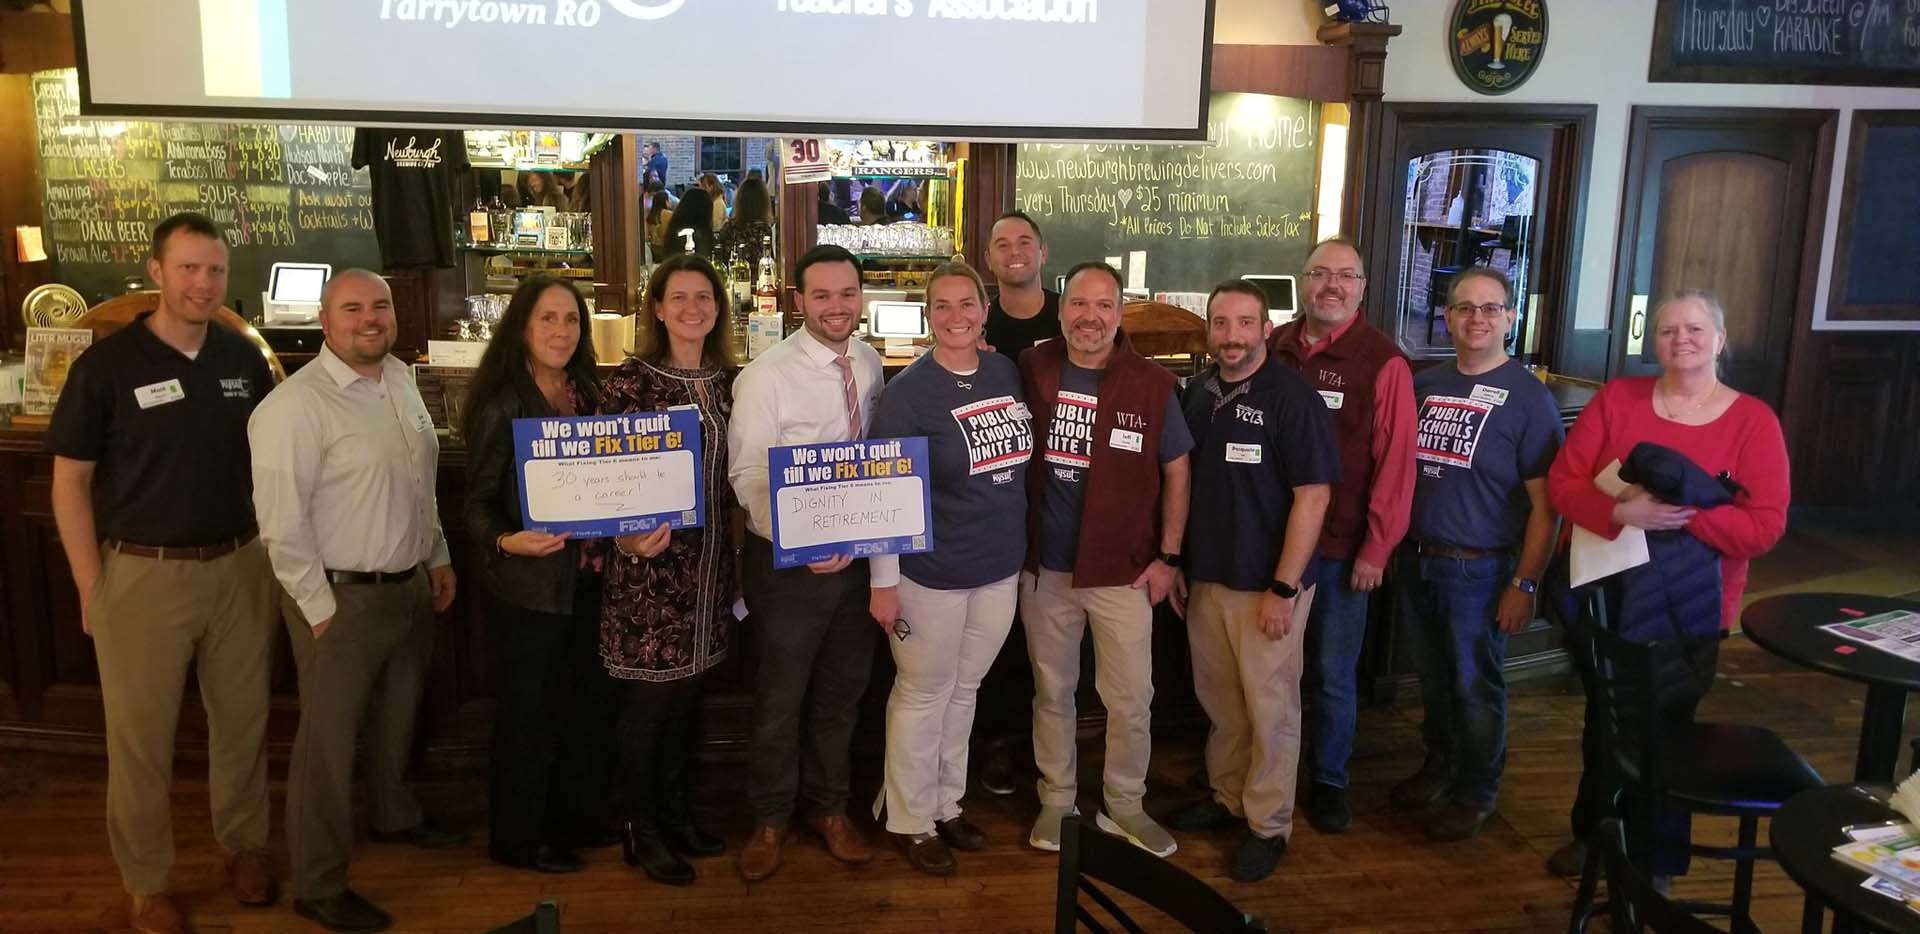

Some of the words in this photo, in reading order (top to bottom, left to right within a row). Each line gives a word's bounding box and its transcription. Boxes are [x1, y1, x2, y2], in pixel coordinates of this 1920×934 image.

[554, 0, 600, 27] RO
[1680, 1, 1755, 53] Thursday
[1773, 16, 1841, 54] KARAOKE
[299, 126, 331, 145] HARD
[384, 136, 442, 168] Newburgh
[790, 139, 820, 164] 30
[74, 156, 126, 179] LAGERS
[857, 167, 934, 176] RANGERS
[299, 190, 321, 207] Ask
[1057, 185, 1118, 226] Thursday
[1136, 186, 1161, 213] $25
[1168, 187, 1230, 213] minimum
[81, 221, 116, 242] DARK
[117, 221, 149, 242] BEER
[299, 209, 348, 231] Cocktails
[1144, 216, 1173, 237] Prices
[1180, 216, 1193, 238] Do
[1196, 216, 1215, 238] Not
[1220, 214, 1253, 237] Include
[1256, 214, 1281, 238] Sales
[541, 420, 571, 439] We
[576, 416, 631, 438] won't
[634, 414, 671, 436] quit
[1426, 405, 1476, 424] PUBLIC
[971, 421, 1028, 447] SCHOOLS
[1417, 418, 1474, 440] SCHOOLS
[532, 440, 557, 458] till
[561, 439, 591, 457] we
[594, 436, 623, 455] Fix
[626, 434, 662, 452] Tier
[665, 431, 683, 449] 6!
[792, 448, 817, 466] We
[821, 443, 867, 463] won't
[869, 440, 903, 462] quit
[972, 438, 1013, 463] UNITE
[1018, 433, 1033, 452] US
[1453, 438, 1473, 456] US
[552, 470, 578, 490] 30
[783, 466, 805, 485] till
[808, 465, 833, 482] we
[835, 463, 859, 480] Fix
[862, 460, 894, 477] Tier
[896, 457, 913, 475] 6!
[792, 491, 848, 514] DIGNITY
[870, 491, 883, 503] IN
[813, 508, 903, 530] RETIREMENT
